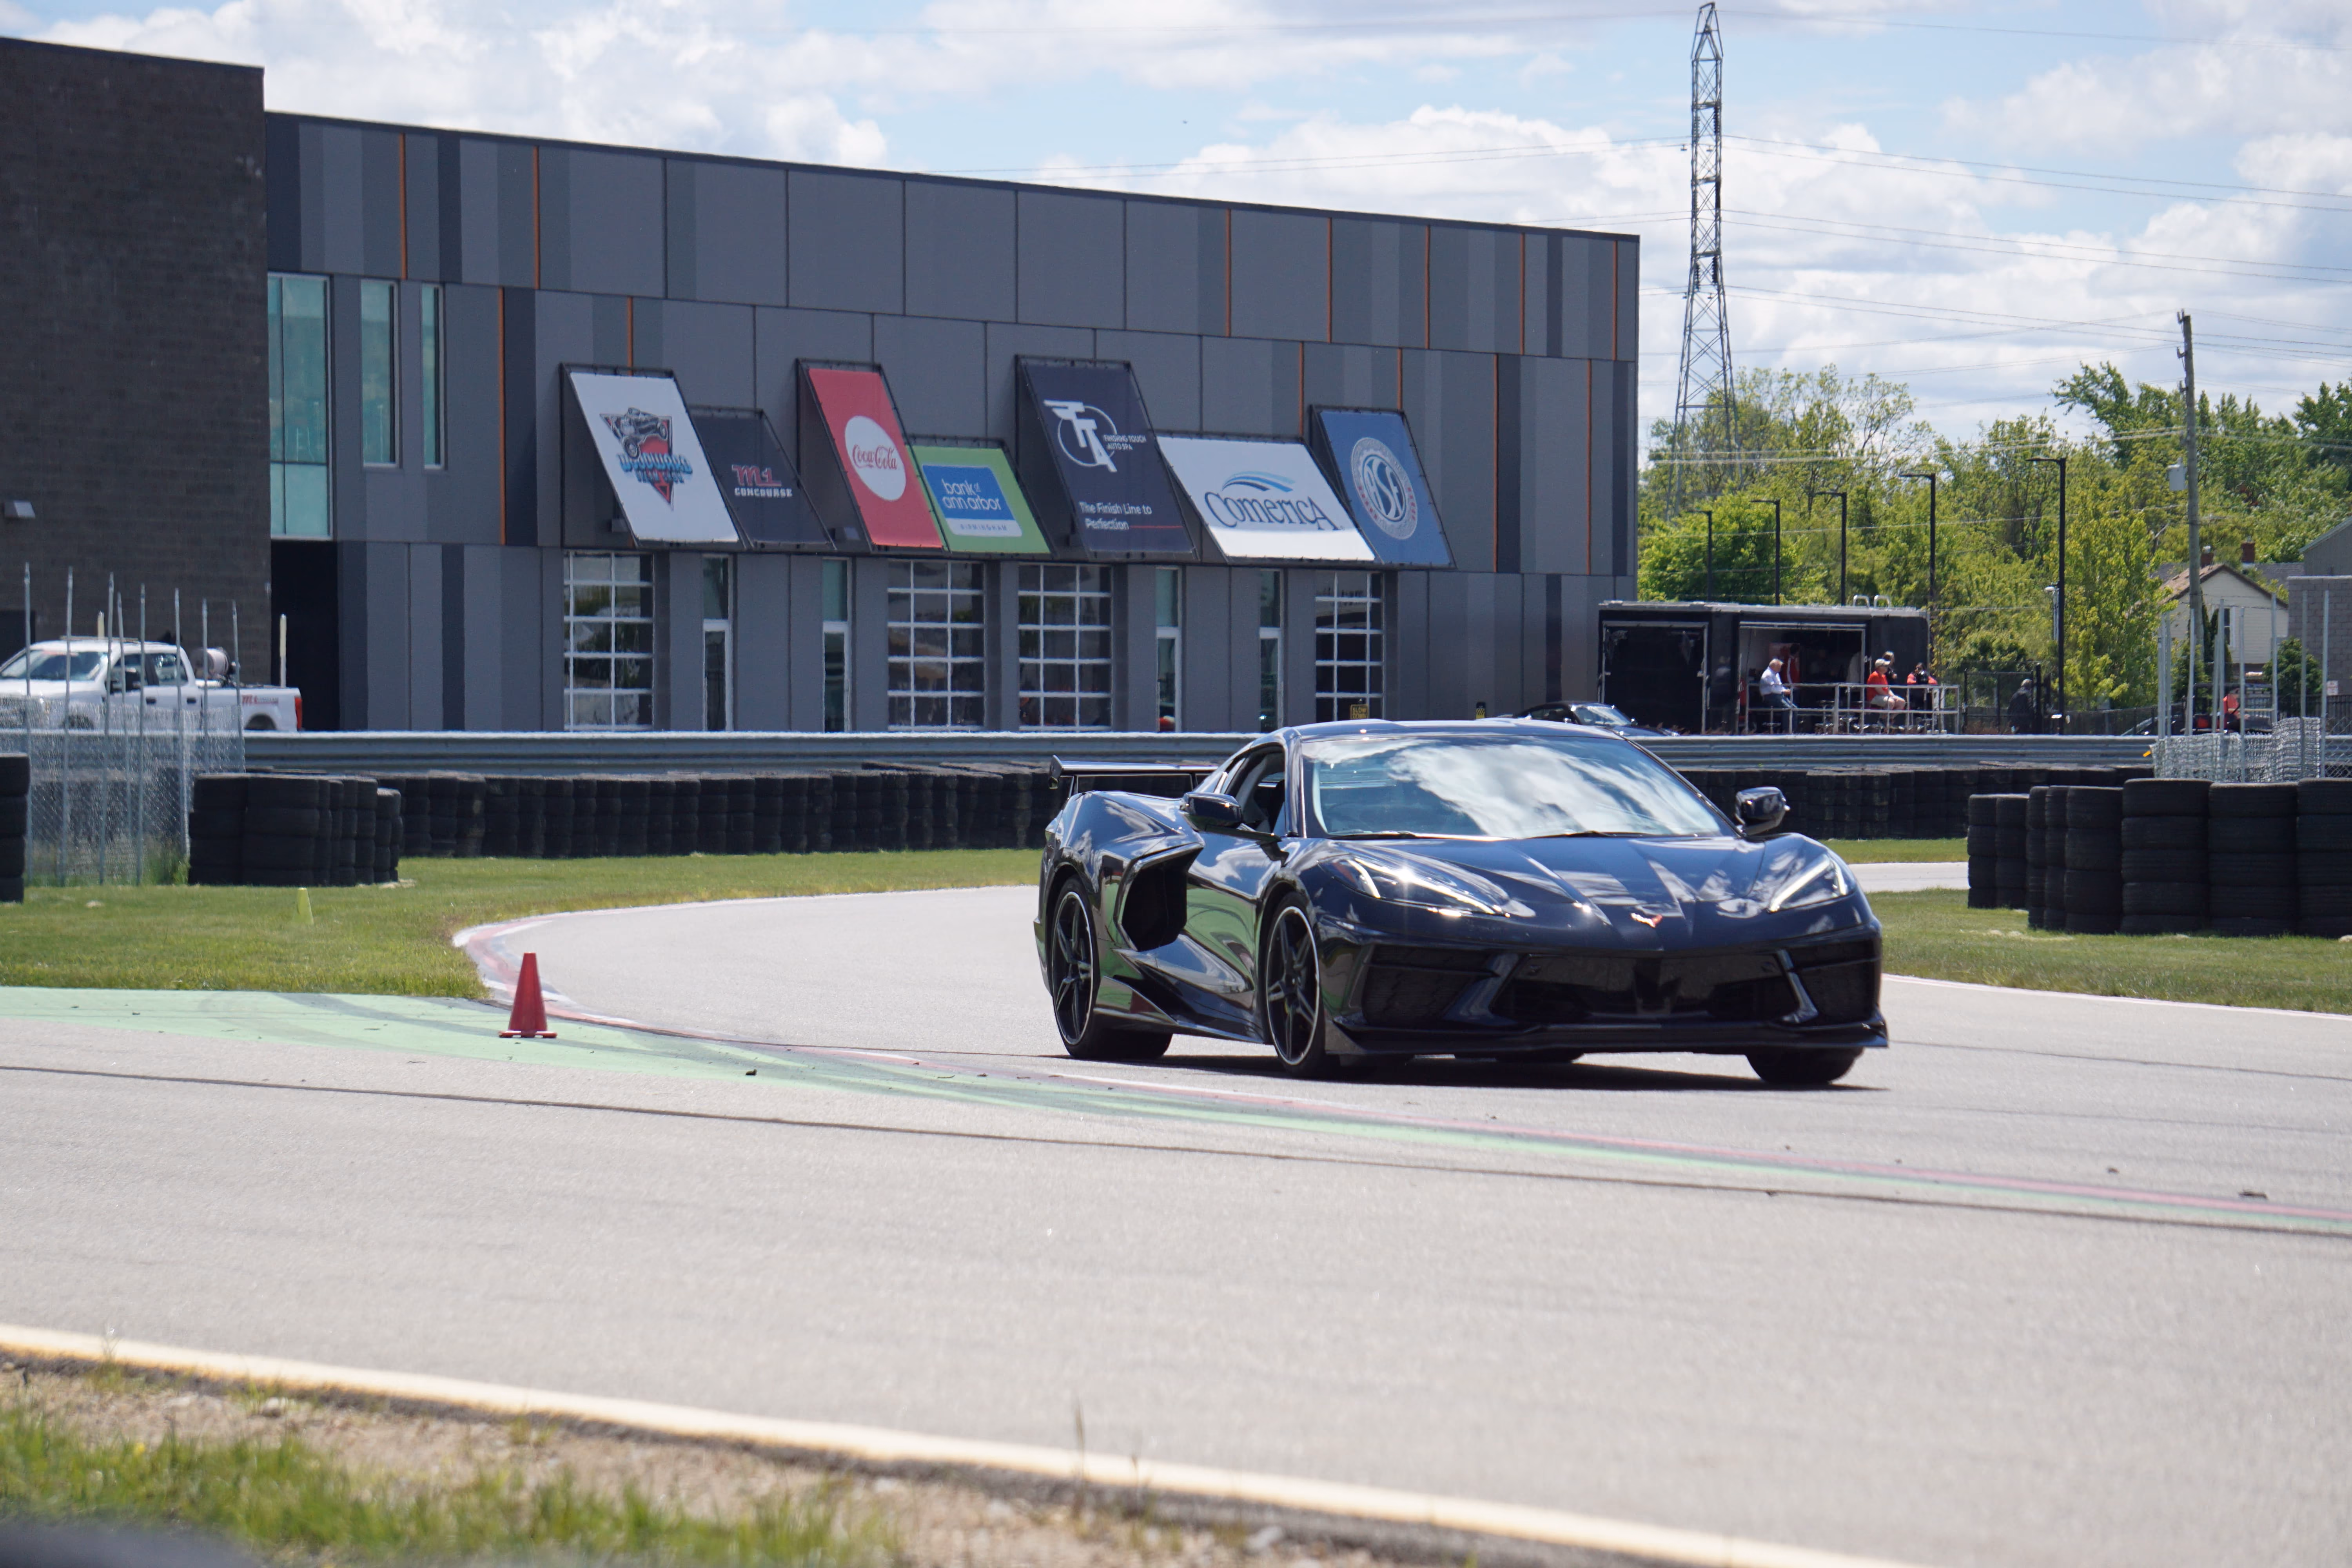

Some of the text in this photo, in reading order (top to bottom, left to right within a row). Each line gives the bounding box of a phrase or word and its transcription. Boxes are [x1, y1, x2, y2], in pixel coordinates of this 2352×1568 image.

[1122, 443, 1134, 451] SPA
[734, 487, 793, 498] CONCOURSE
[942, 478, 976, 495] bank
[942, 495, 1002, 510] ann arbor
[1079, 501, 1152, 515] The Finish Line to
[1085, 518, 1129, 530] Perfection
